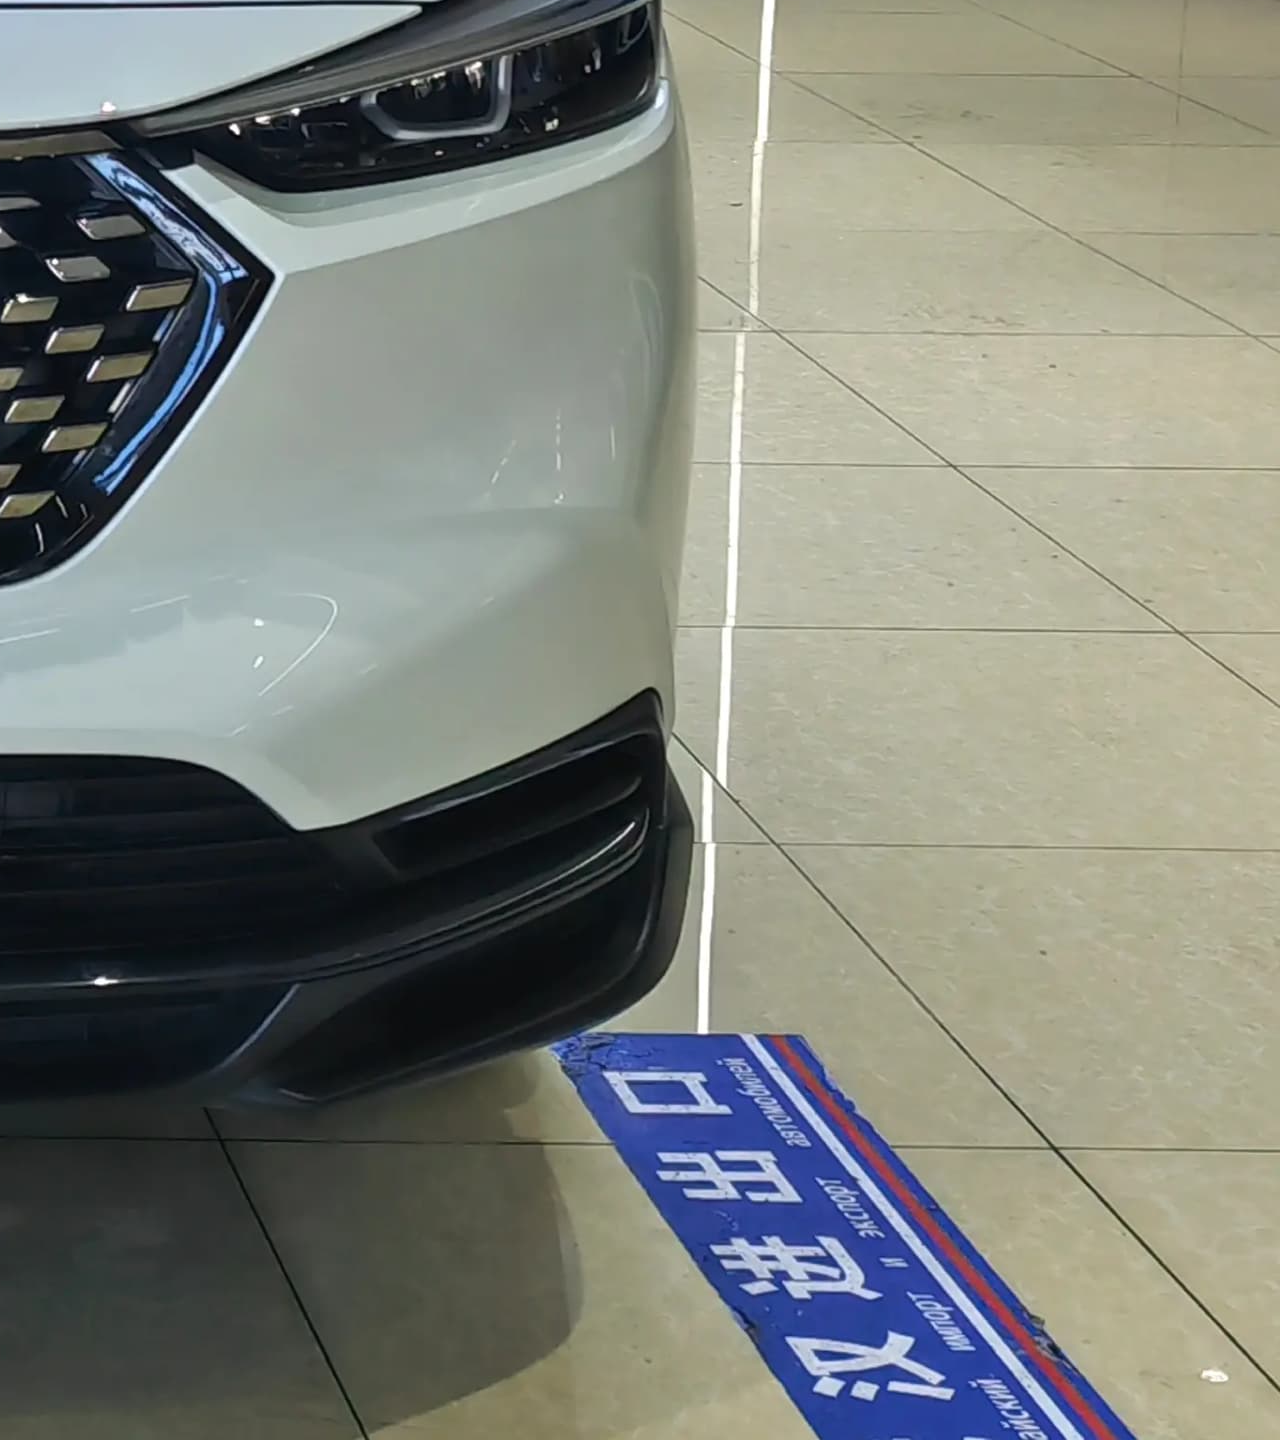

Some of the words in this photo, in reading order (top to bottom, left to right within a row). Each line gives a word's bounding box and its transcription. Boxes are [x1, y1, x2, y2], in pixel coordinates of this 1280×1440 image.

[715, 1057, 813, 1148] автомобилей
[814, 1176, 886, 1239] экспорт
[602, 1070, 992, 1440] 汉进出口
[879, 1257, 909, 1268] и
[906, 1291, 977, 1351] импорт
